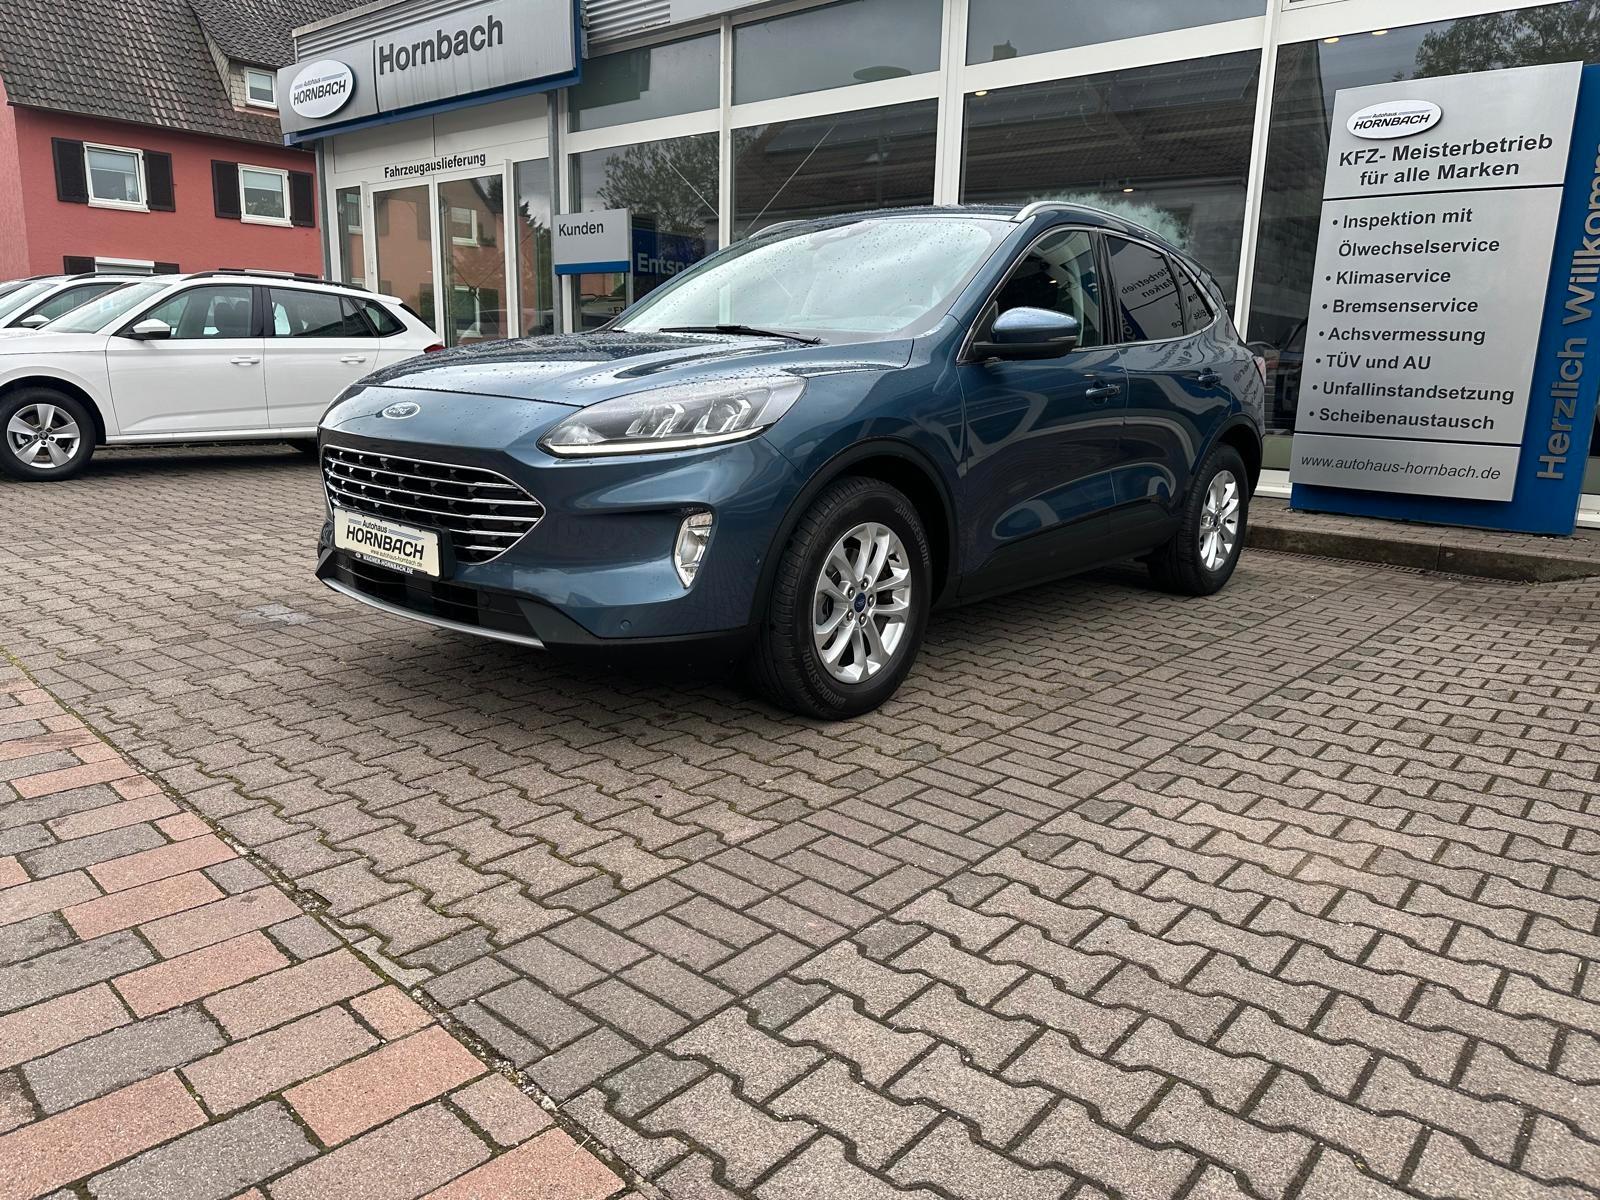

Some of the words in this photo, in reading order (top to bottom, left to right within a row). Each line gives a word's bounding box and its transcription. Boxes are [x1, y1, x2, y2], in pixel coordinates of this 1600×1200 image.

[378, 15, 503, 75] Hornbach
[293, 80, 346, 106] HORNBACH
[303, 78, 321, 87] Autohaus
[1353, 114, 1431, 130] HORNBACH
[1339, 148, 1386, 167] KFZ-
[1391, 134, 1553, 162] Meisterbetrieb
[384, 153, 486, 178] Fahrzeugauslieferung
[1360, 171, 1388, 186] für
[1393, 167, 1430, 183] alle
[1437, 162, 1520, 180] Marken
[558, 221, 604, 237] Kunden
[1343, 211, 1436, 230] Inspektion
[1442, 208, 1473, 223] mit
[1338, 238, 1500, 257] Ölwechselservice
[1336, 269, 1451, 285] Klimaservice
[1332, 298, 1479, 313] Bremsenservice
[1328, 327, 1486, 345] Achsvermessung
[1326, 352, 1361, 368] TÜV
[1366, 355, 1399, 369] und
[1403, 356, 1431, 370] AU
[1323, 381, 1515, 405] Unfallinstandsetzung
[1319, 408, 1495, 430] Scheibenaustausch
[1536, 337, 1587, 480] Herzlich
[1301, 455, 1501, 480] www.autohaus-hornbach.de
[362, 519, 388, 534] Autohaus
[894, 503, 931, 569] BRIDGESTONE
[346, 525, 424, 560] HORNBACH
